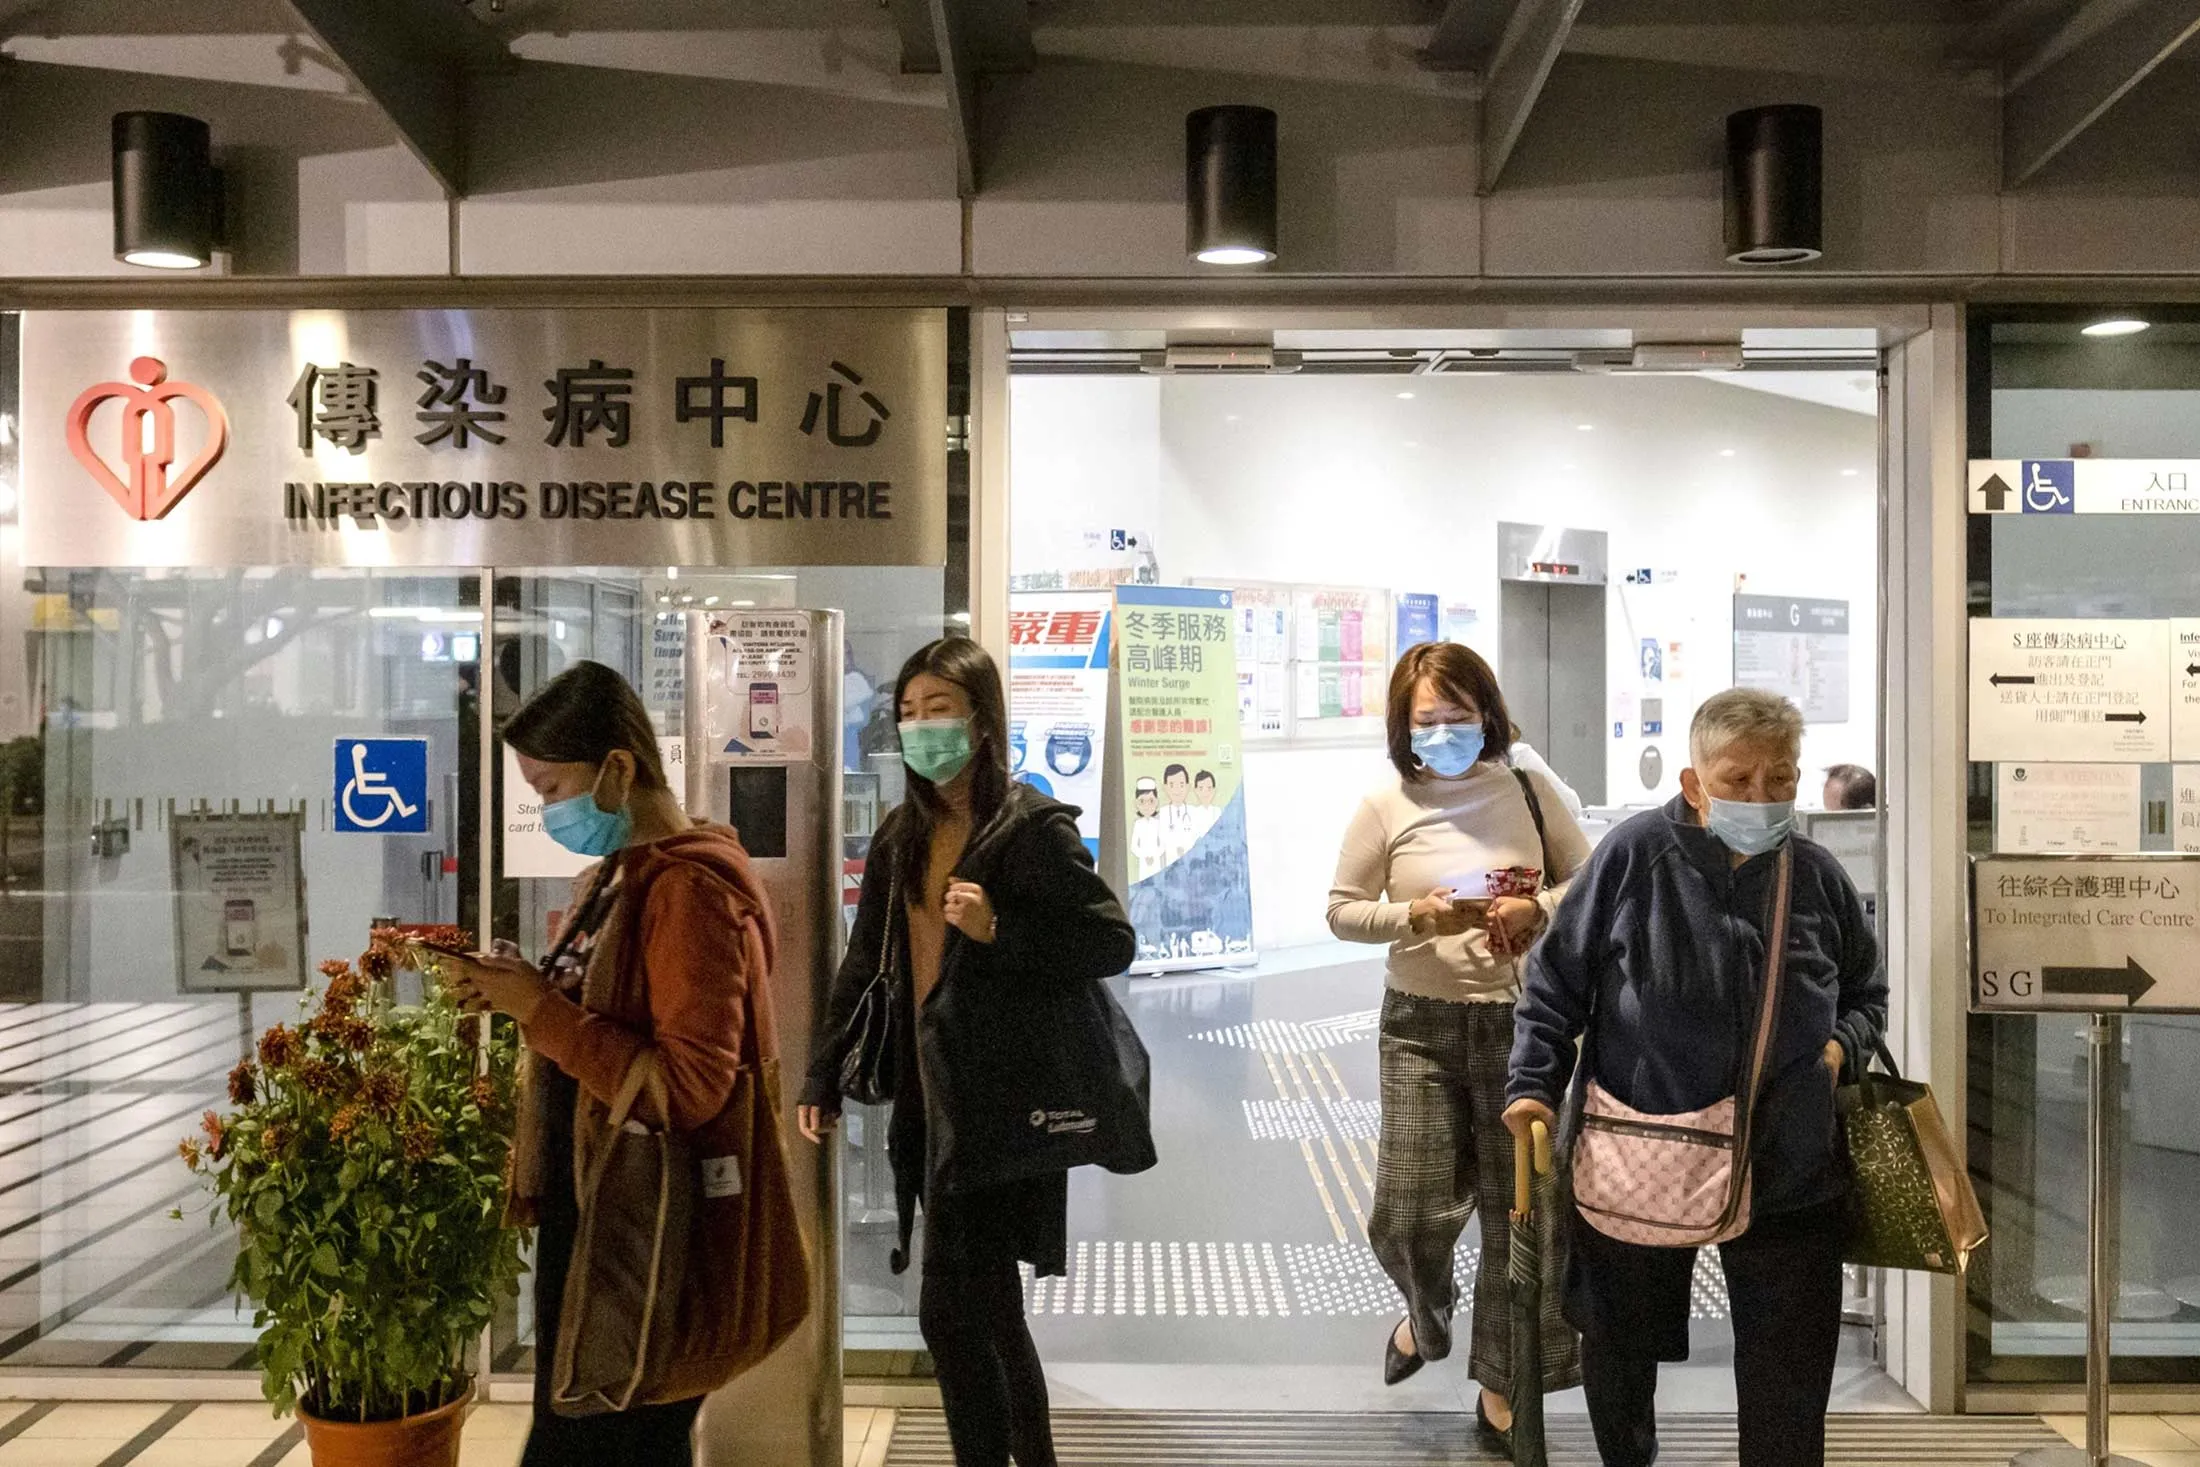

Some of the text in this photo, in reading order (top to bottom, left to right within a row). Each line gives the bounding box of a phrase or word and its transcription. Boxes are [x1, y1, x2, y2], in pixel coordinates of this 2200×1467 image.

[287, 356, 891, 450] 傳染病中心
[2145, 472, 2187, 491] 入口
[285, 480, 891, 521] INFECTIOUS DISEASE CENTRE
[1790, 604, 1800, 627] G
[1125, 611, 1226, 643] 冬季服務
[1127, 645, 1203, 673] 高峰期
[2028, 655, 2112, 669] 訪客請在正門
[1128, 677, 1191, 691] Winter Surge
[2182, 680, 2197, 689] For
[508, 822, 534, 833] card
[1998, 875, 2180, 899] 往綜合護理中心
[1984, 909, 2195, 928] To Integrated Care Centre
